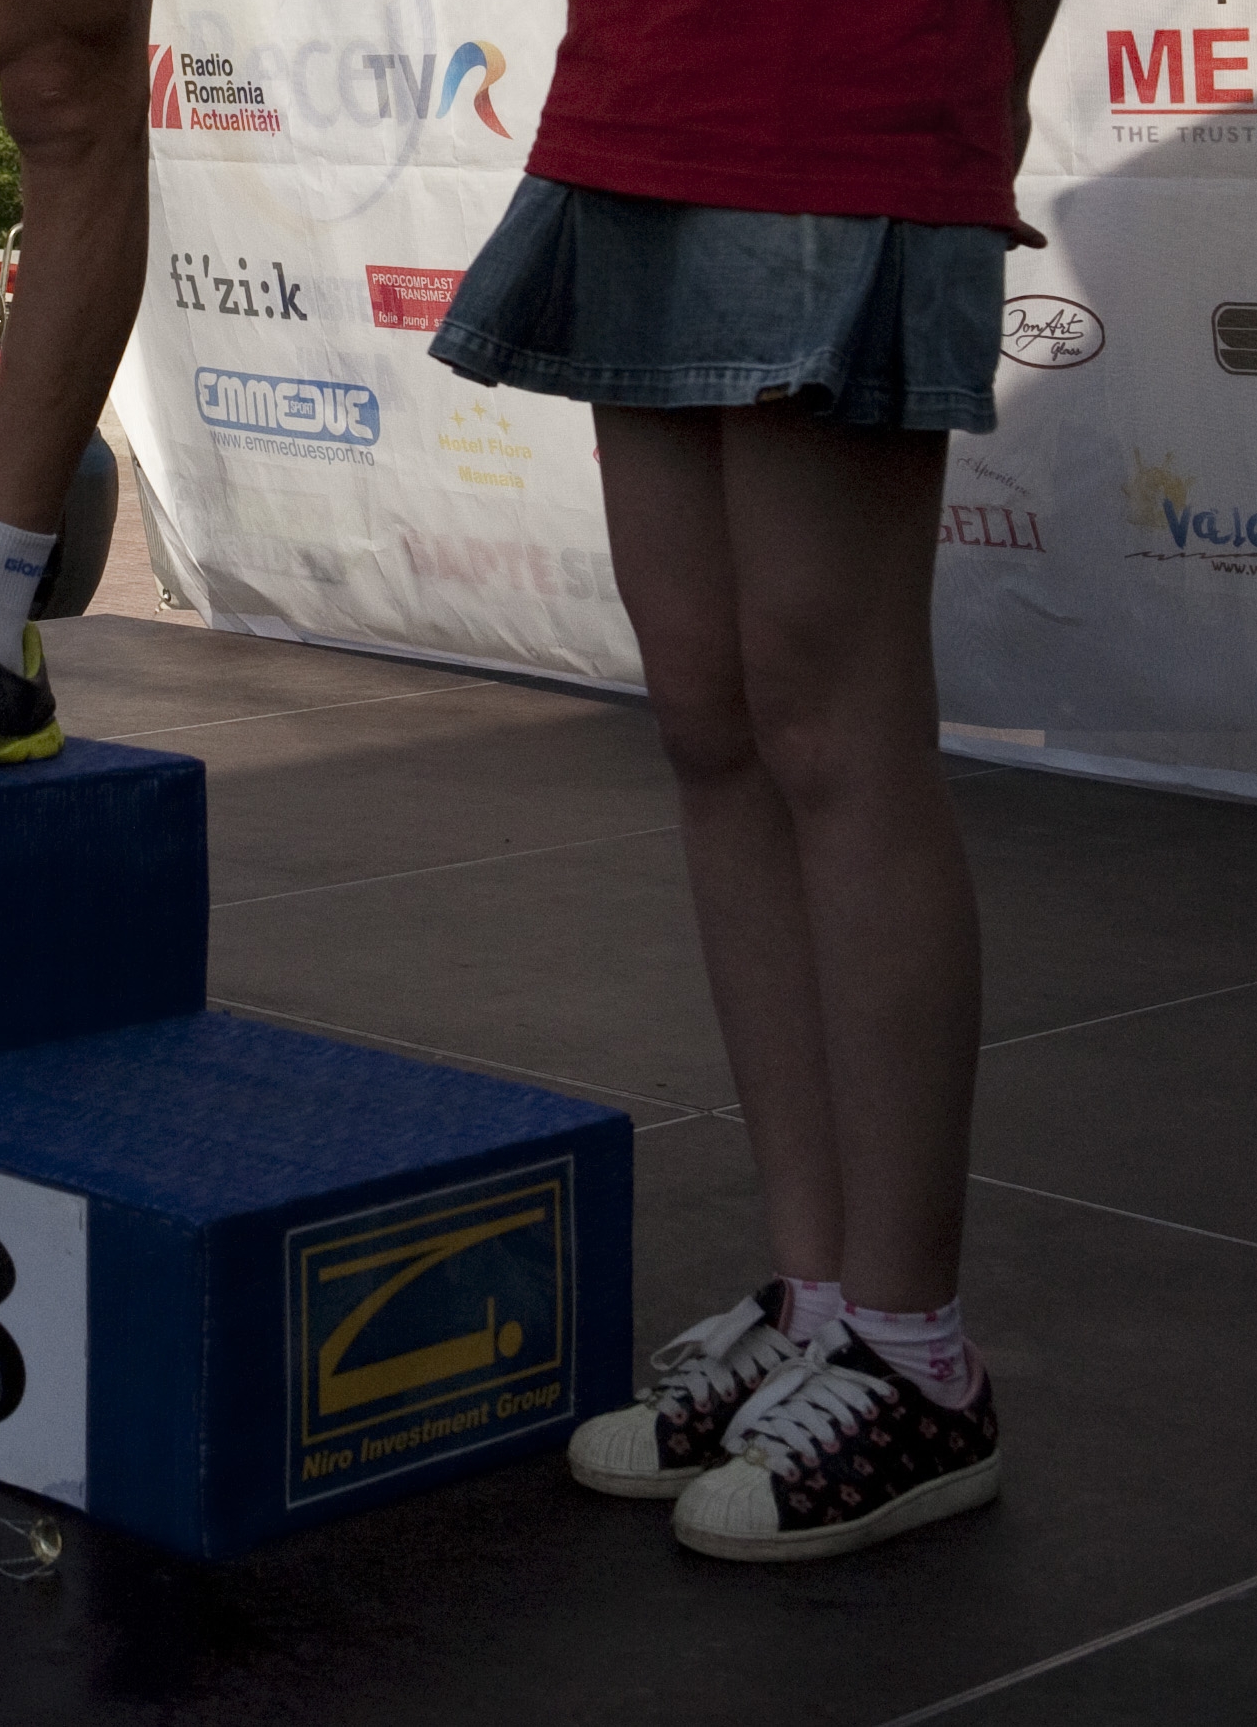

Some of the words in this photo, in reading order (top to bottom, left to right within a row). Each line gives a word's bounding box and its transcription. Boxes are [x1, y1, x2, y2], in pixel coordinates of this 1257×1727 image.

[180, 53, 234, 77] Radio
[1106, 27, 1254, 104] ME
[184, 80, 265, 105] România
[1111, 125, 1159, 143] THE
[1177, 125, 1256, 143] TRUST
[371, 273, 454, 290] PRODCOMPLAST
[394, 287, 453, 303] TRANSIMEX
[378, 311, 398, 324] folie
[402, 315, 429, 329] pungi
[289, 400, 314, 416] SPORT
[209, 430, 375, 467] www.emmeduesport.ro
[438, 433, 484, 455] Hotel
[488, 438, 533, 460] Flora
[458, 465, 526, 489] Mamaia
[301, 1447, 354, 1482] Niro
[360, 1404, 491, 1464] Investment
[495, 1381, 562, 1420] Group
